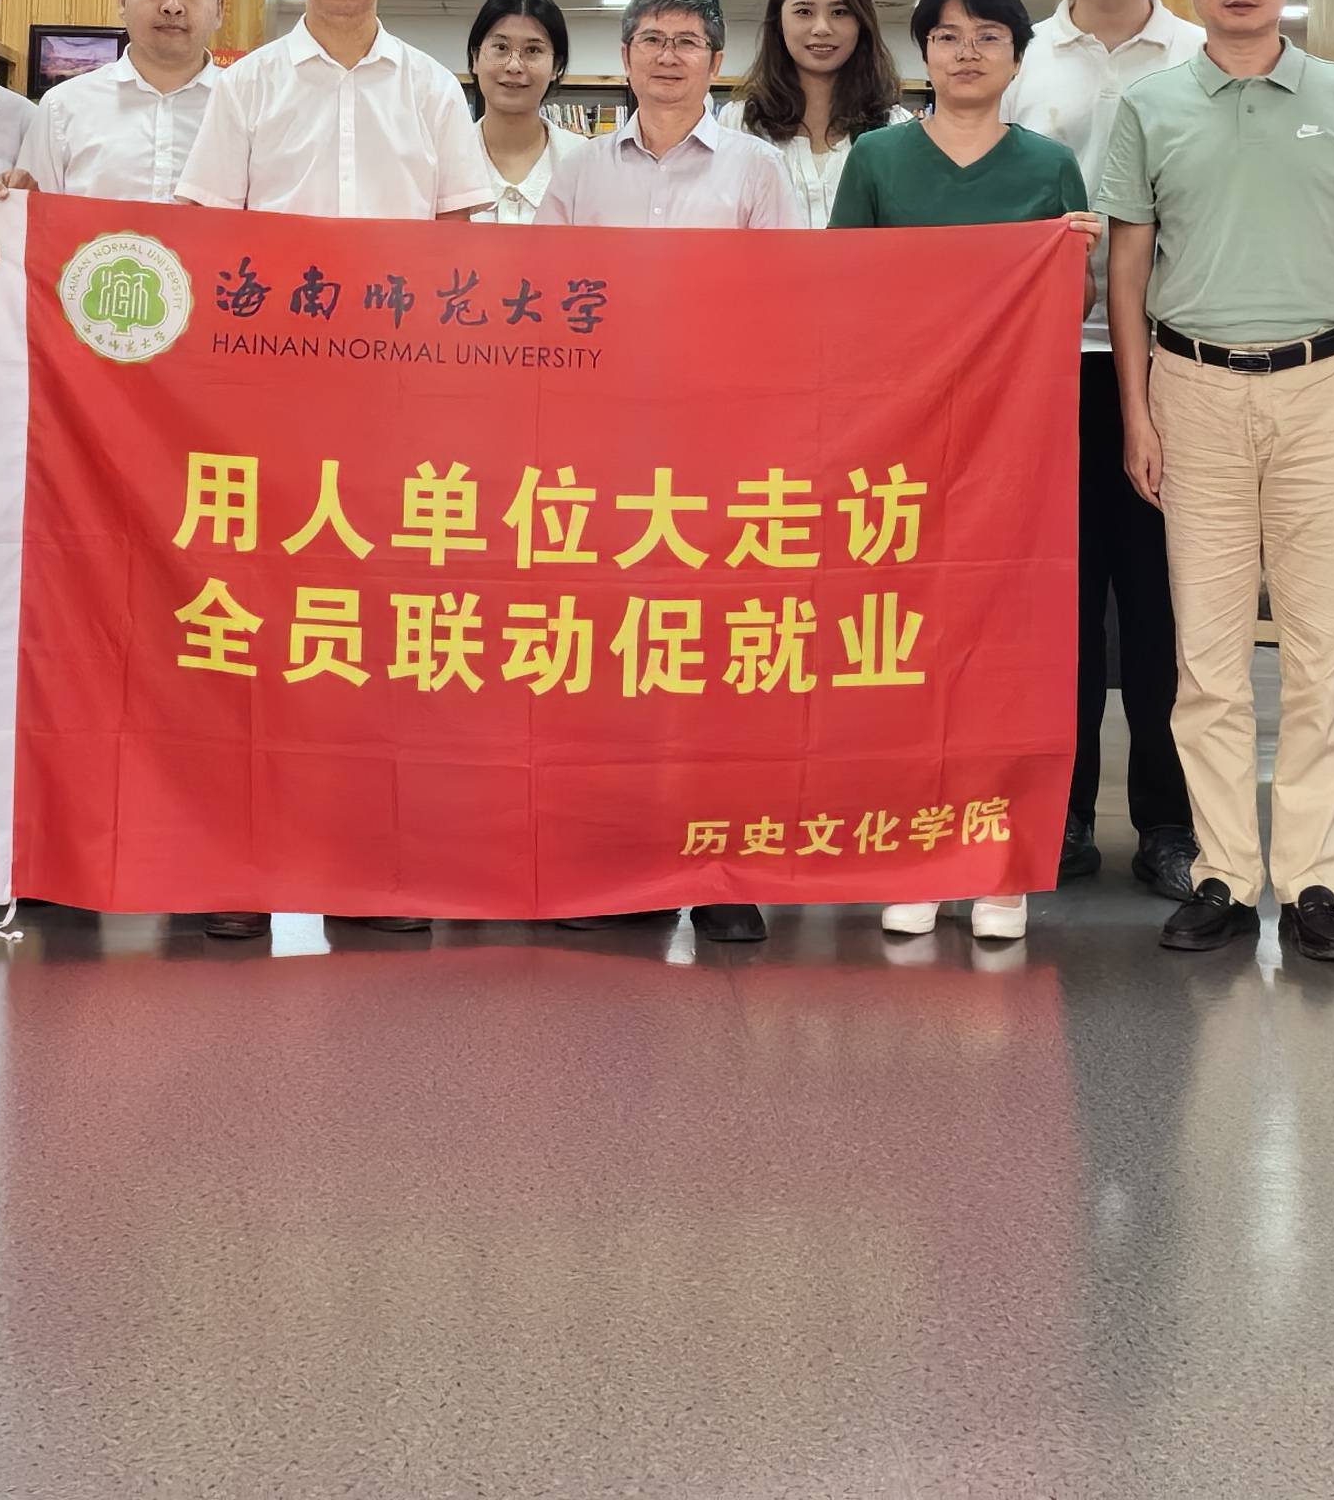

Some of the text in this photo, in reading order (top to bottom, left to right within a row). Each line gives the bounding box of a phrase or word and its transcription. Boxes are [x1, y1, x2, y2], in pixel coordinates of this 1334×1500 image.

[216, 256, 608, 334] 海南师范大学
[212, 333, 602, 369] HAINAN NORMAL UNIVERSITY
[173, 451, 929, 570] 用人单位大走访
[174, 578, 926, 698] 全员联动促就业
[680, 796, 1011, 857] 历史文化学院
